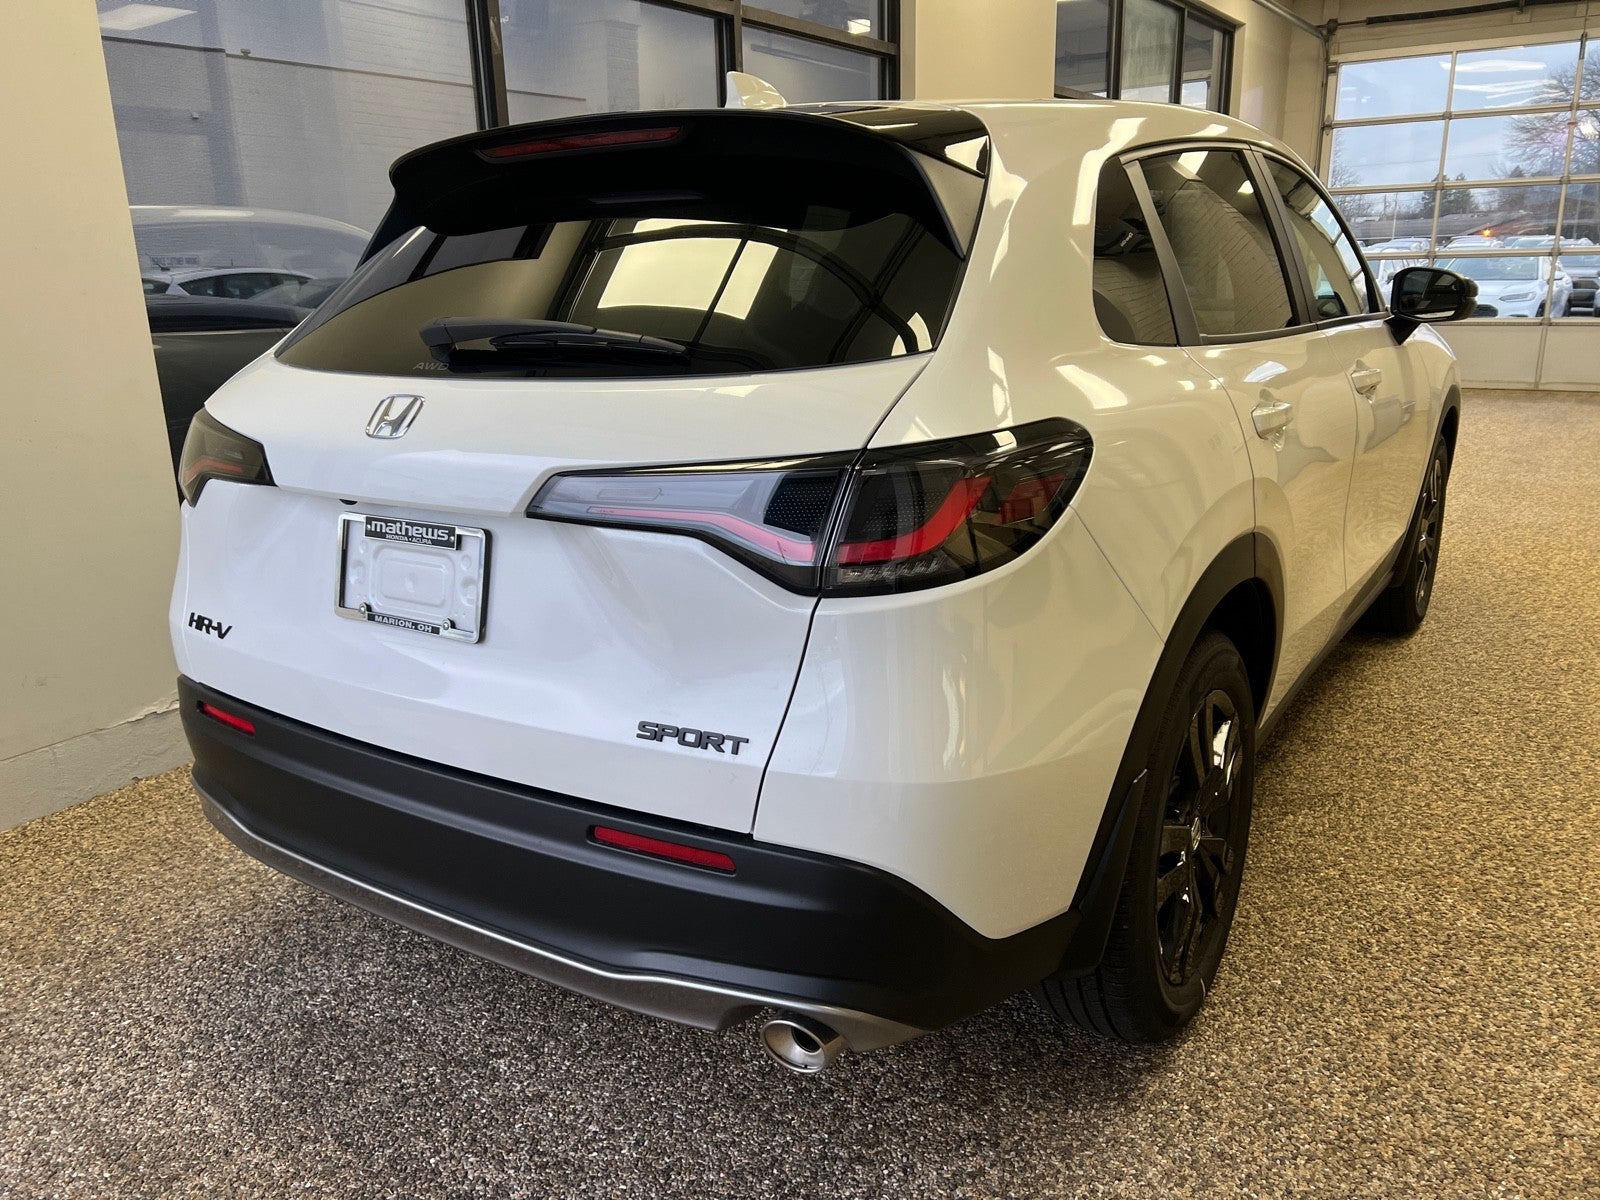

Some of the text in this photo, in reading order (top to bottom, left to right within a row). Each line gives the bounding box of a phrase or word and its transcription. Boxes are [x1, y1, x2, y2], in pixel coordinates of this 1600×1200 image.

[412, 362, 449, 371] AWD
[371, 520, 449, 541] mathews
[385, 534, 432, 545] HONDA ACURA
[188, 612, 233, 639] HR-V
[374, 615, 432, 633] MARION, OH
[636, 720, 749, 755] SPORT
